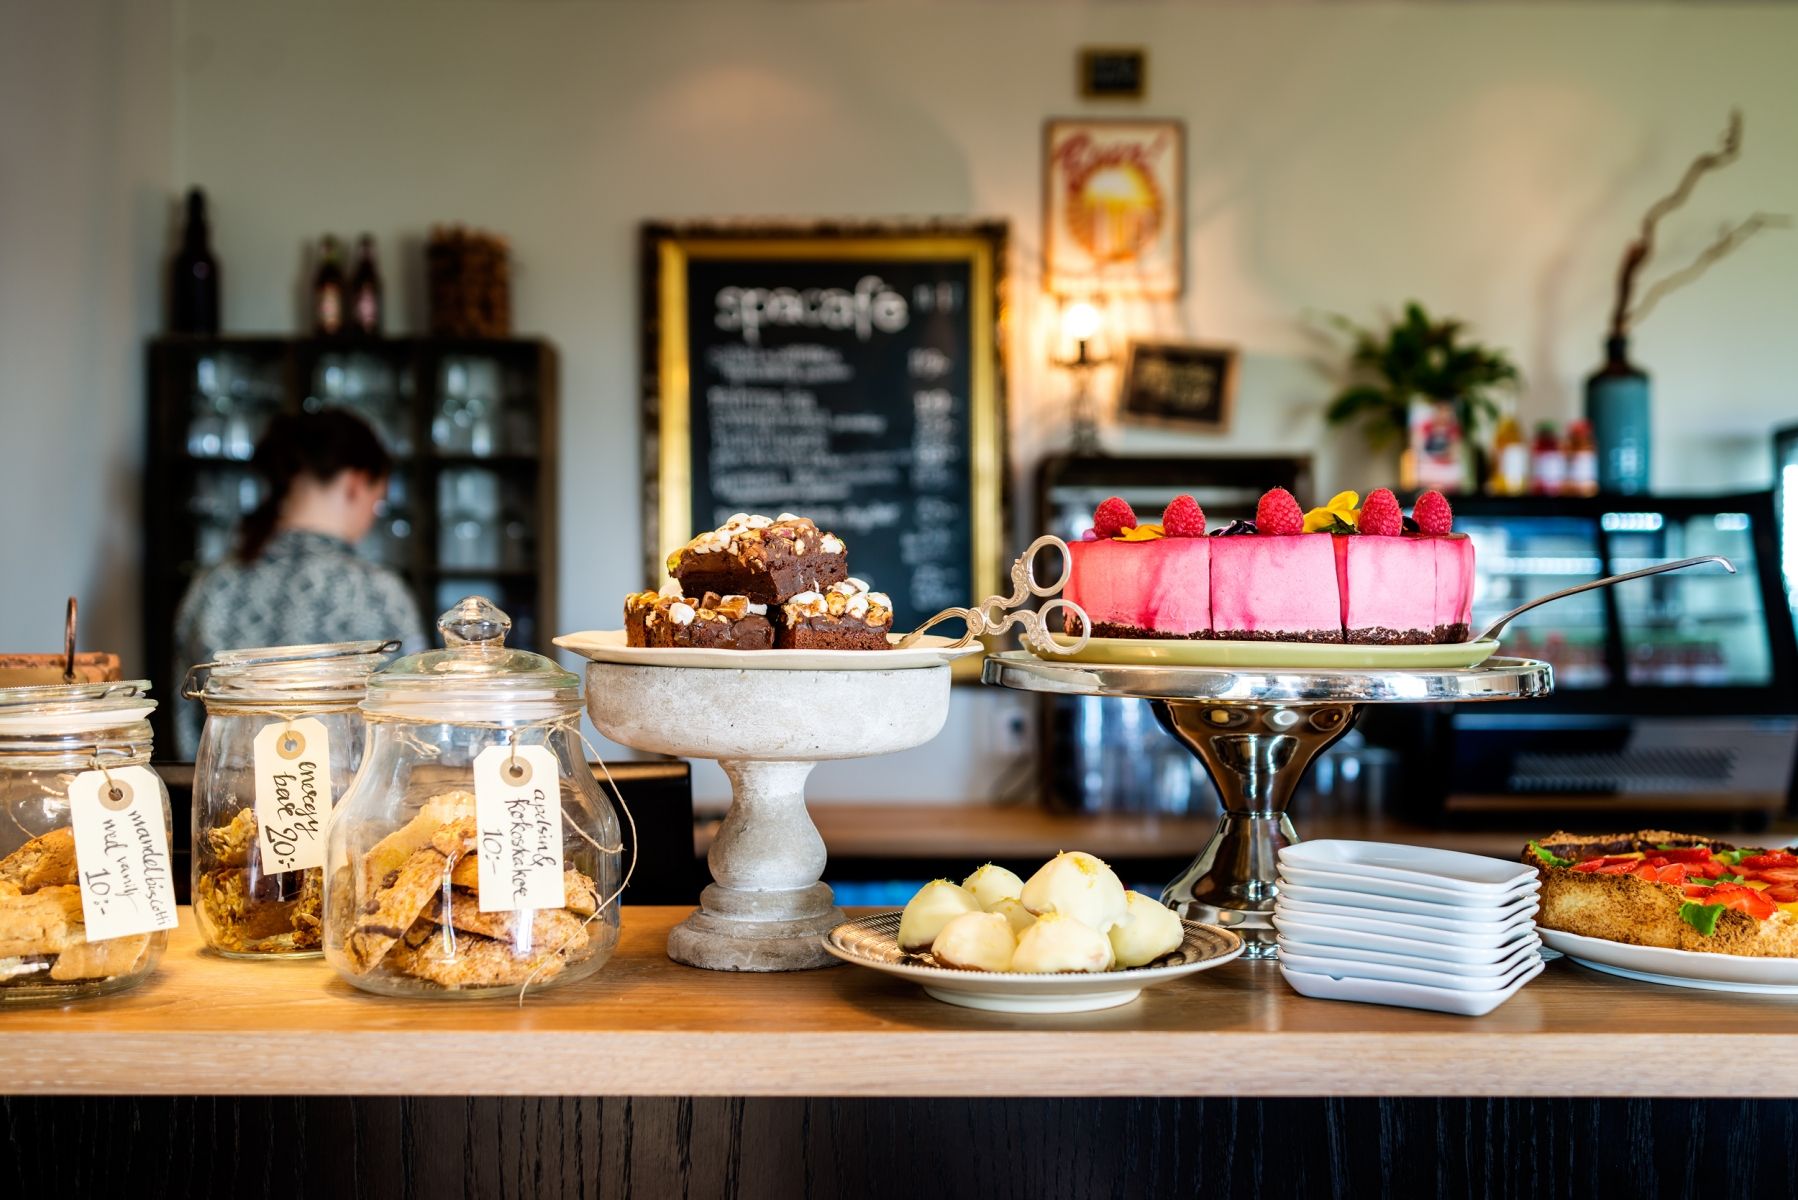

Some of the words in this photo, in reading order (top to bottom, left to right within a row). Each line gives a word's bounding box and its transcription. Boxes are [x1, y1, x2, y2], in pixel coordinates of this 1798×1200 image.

[272, 771, 296, 821] bar
[294, 761, 319, 841] energy
[102, 818, 128, 857] med
[264, 824, 298, 872] 20:-
[482, 828, 504, 875] 10:-
[84, 868, 111, 916] 10:-
[127, 810, 169, 926] mandelbiscotti
